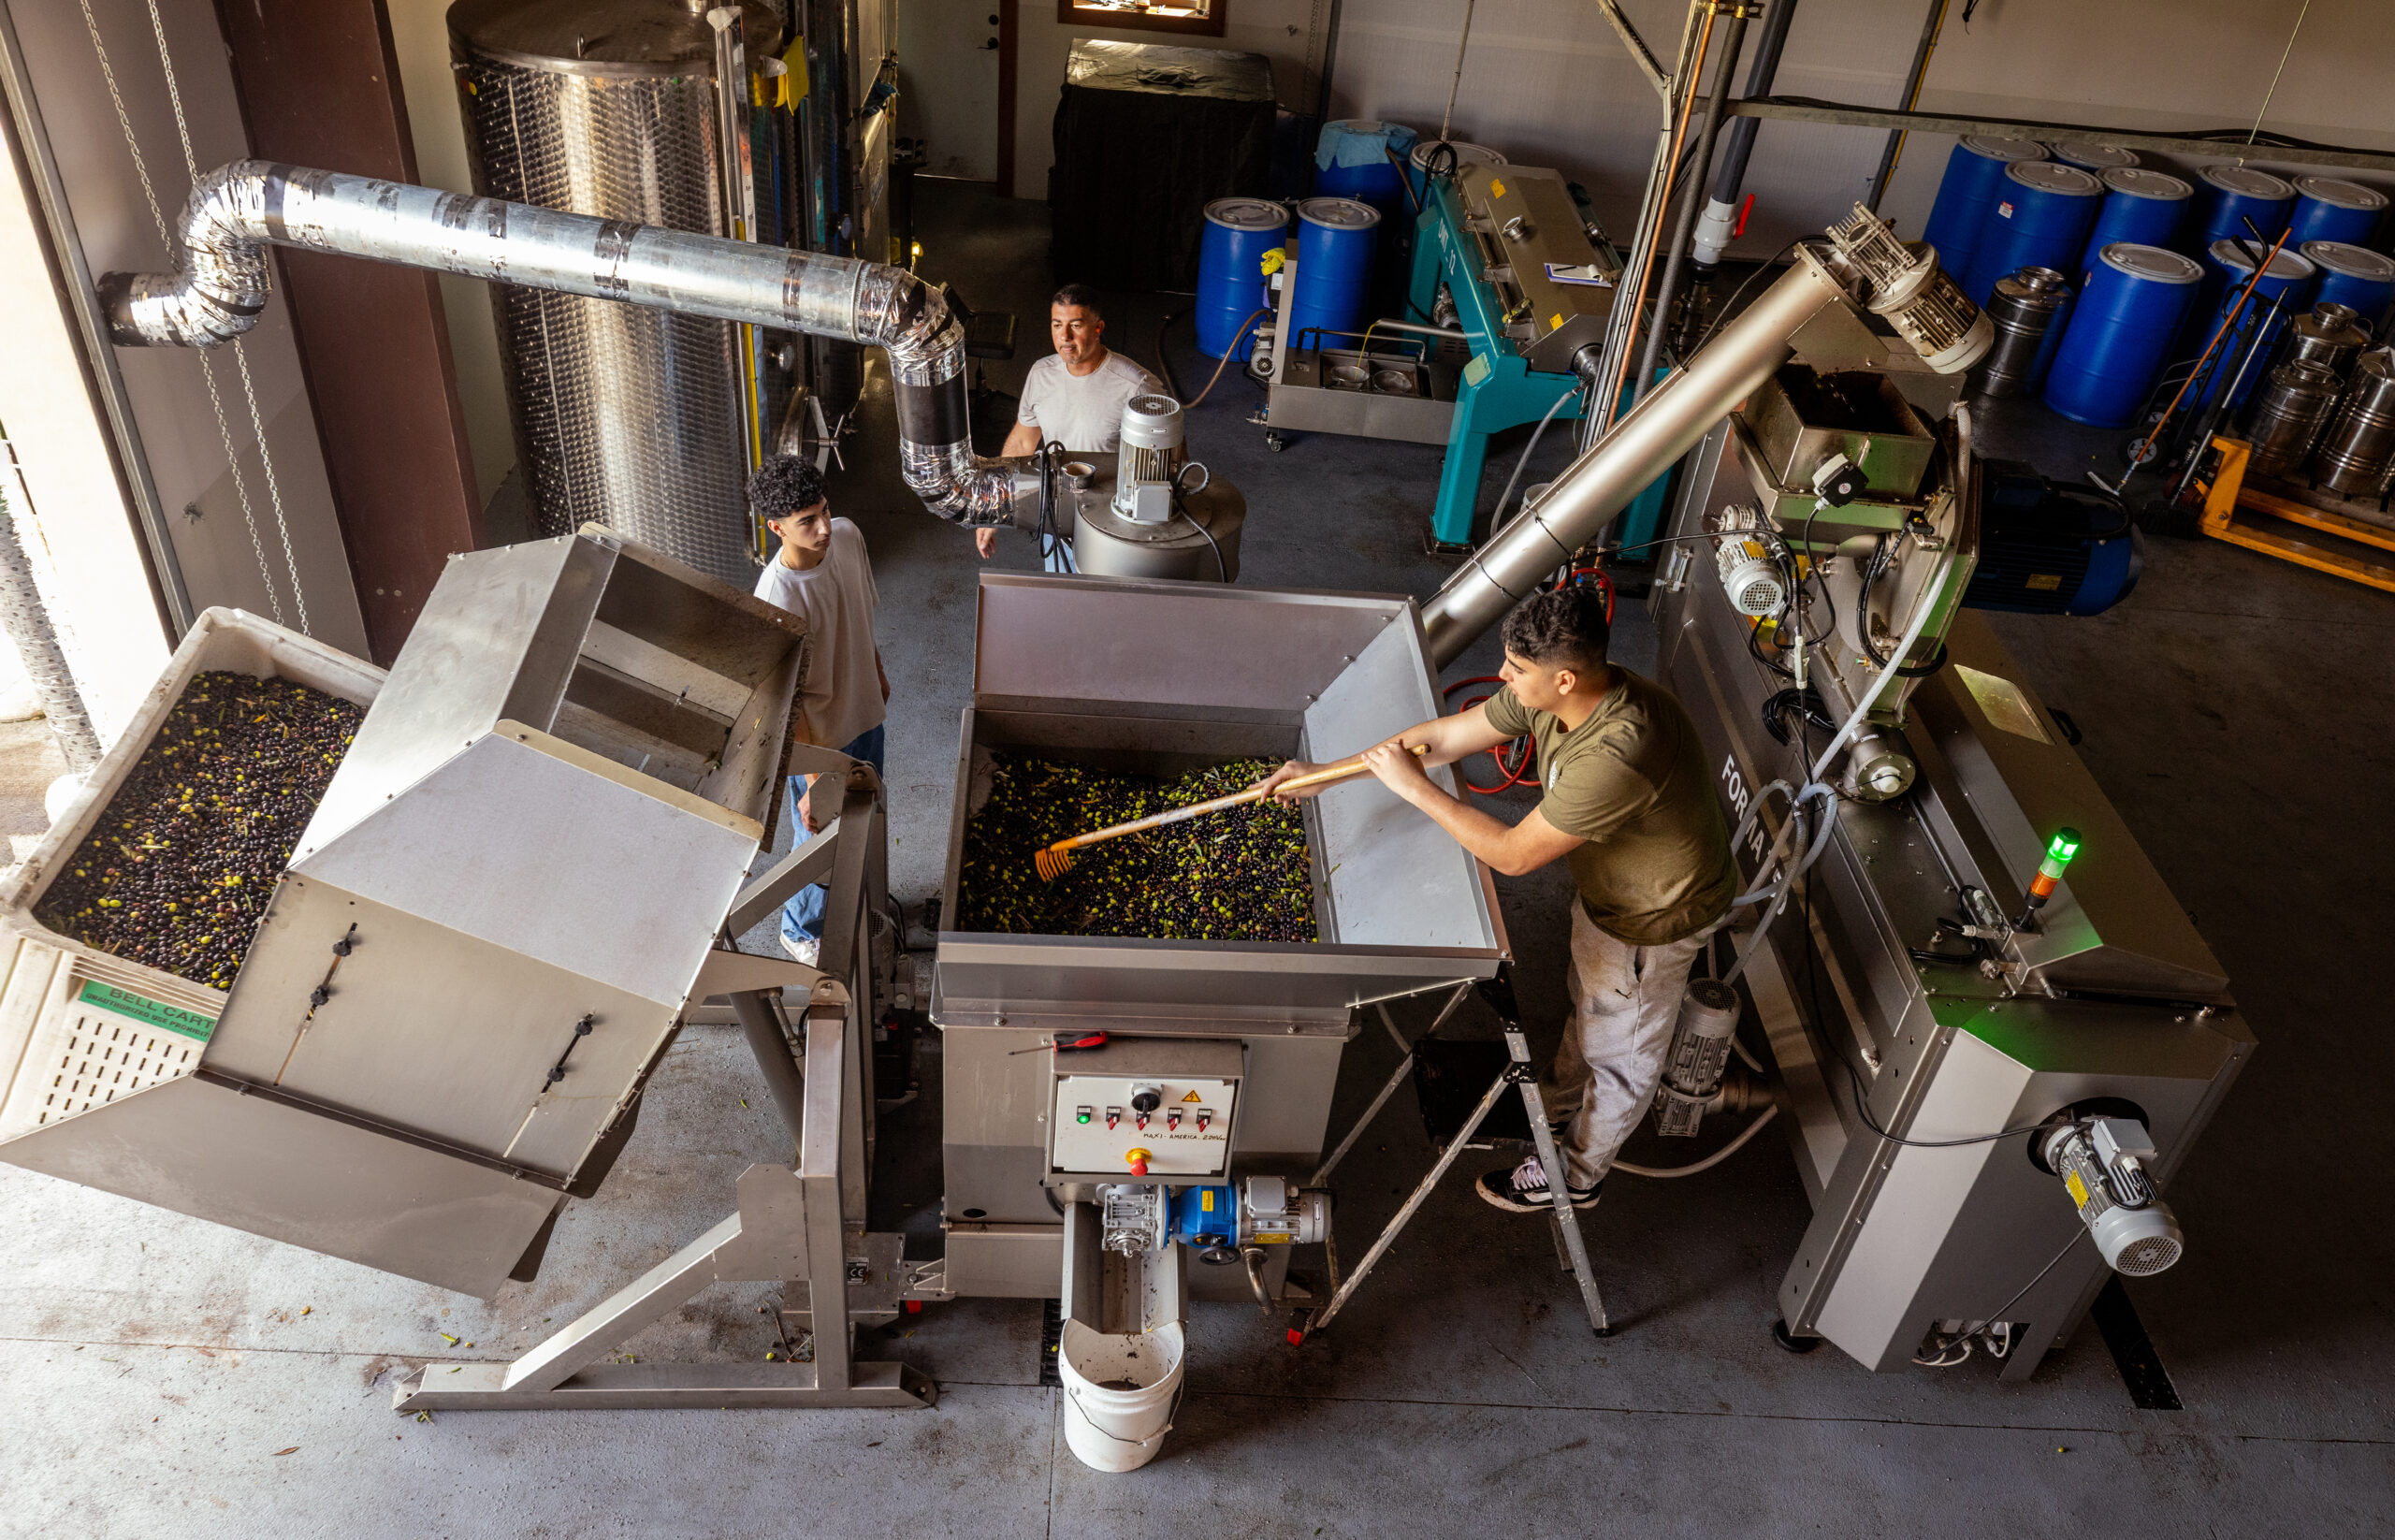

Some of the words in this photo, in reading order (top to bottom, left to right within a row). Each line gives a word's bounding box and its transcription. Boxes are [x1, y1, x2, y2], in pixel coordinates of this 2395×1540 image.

[85, 992, 150, 1018] UNAUTHORIZED
[152, 1014, 168, 1024] USE
[169, 1021, 210, 1038] PROHIBIT
[109, 987, 157, 1011] BELL
[164, 1007, 216, 1028] CART
